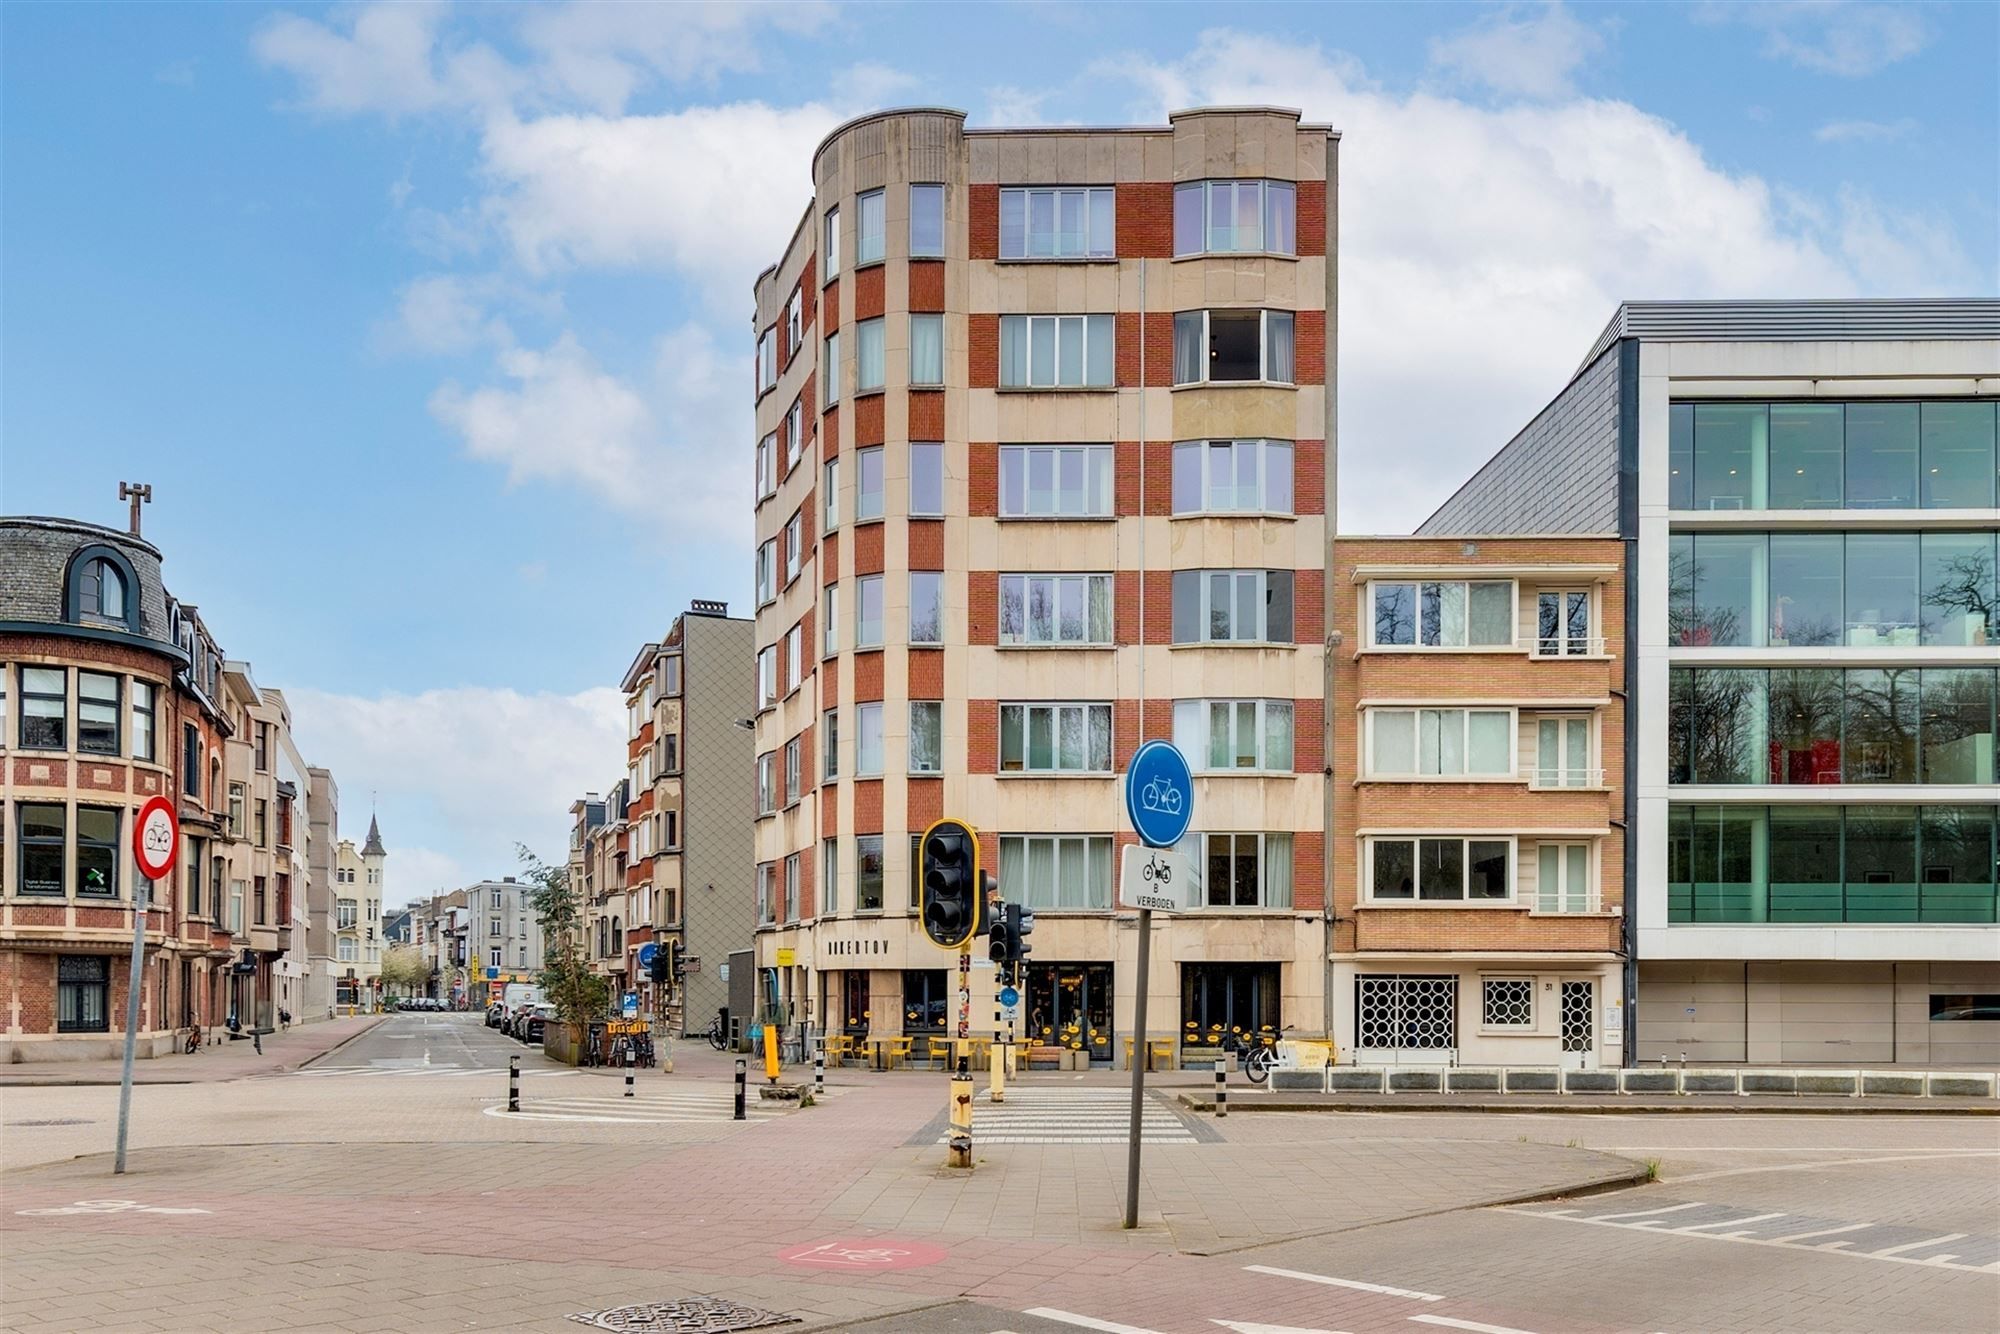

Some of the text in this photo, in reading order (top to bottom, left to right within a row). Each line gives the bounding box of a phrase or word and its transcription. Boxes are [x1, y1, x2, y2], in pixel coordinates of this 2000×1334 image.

[1153, 883, 1159, 893] B
[1136, 895, 1176, 909] VERBODEN
[1545, 983, 1553, 991] 31
[624, 995, 631, 1005] P
